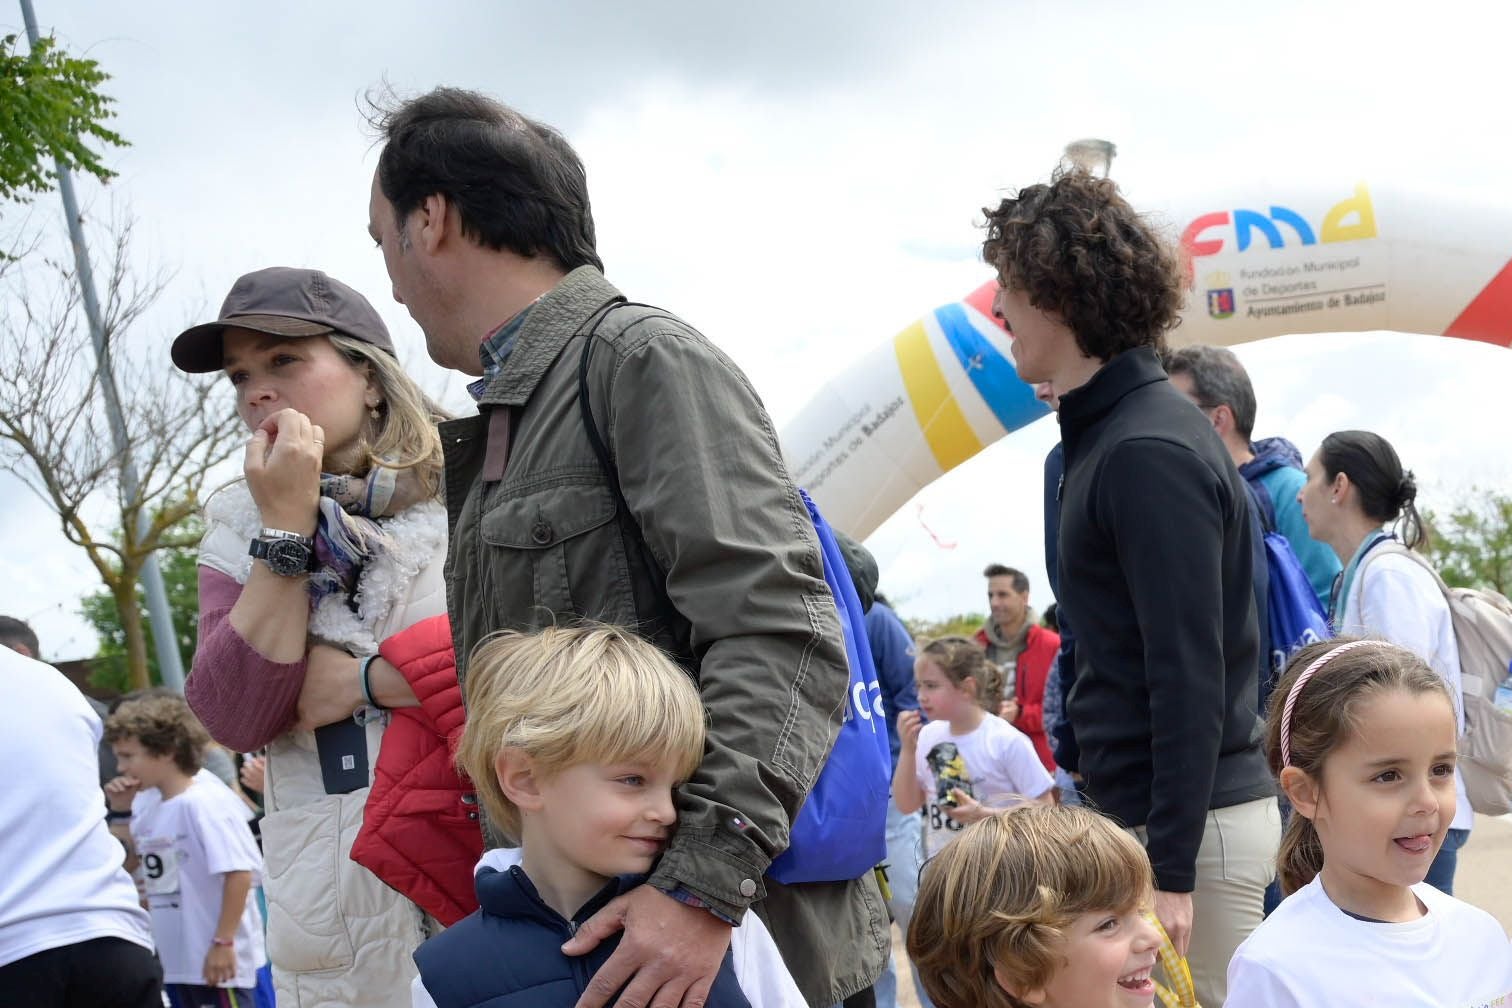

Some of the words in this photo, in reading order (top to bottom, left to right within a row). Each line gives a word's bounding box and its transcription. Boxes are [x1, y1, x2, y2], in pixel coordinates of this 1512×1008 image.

[1303, 257, 1360, 273] Municipal
[1243, 284, 1258, 296] de
[1262, 280, 1317, 297] Deportes
[1246, 300, 1323, 318] Ayuntamiento
[1327, 294, 1341, 308] de
